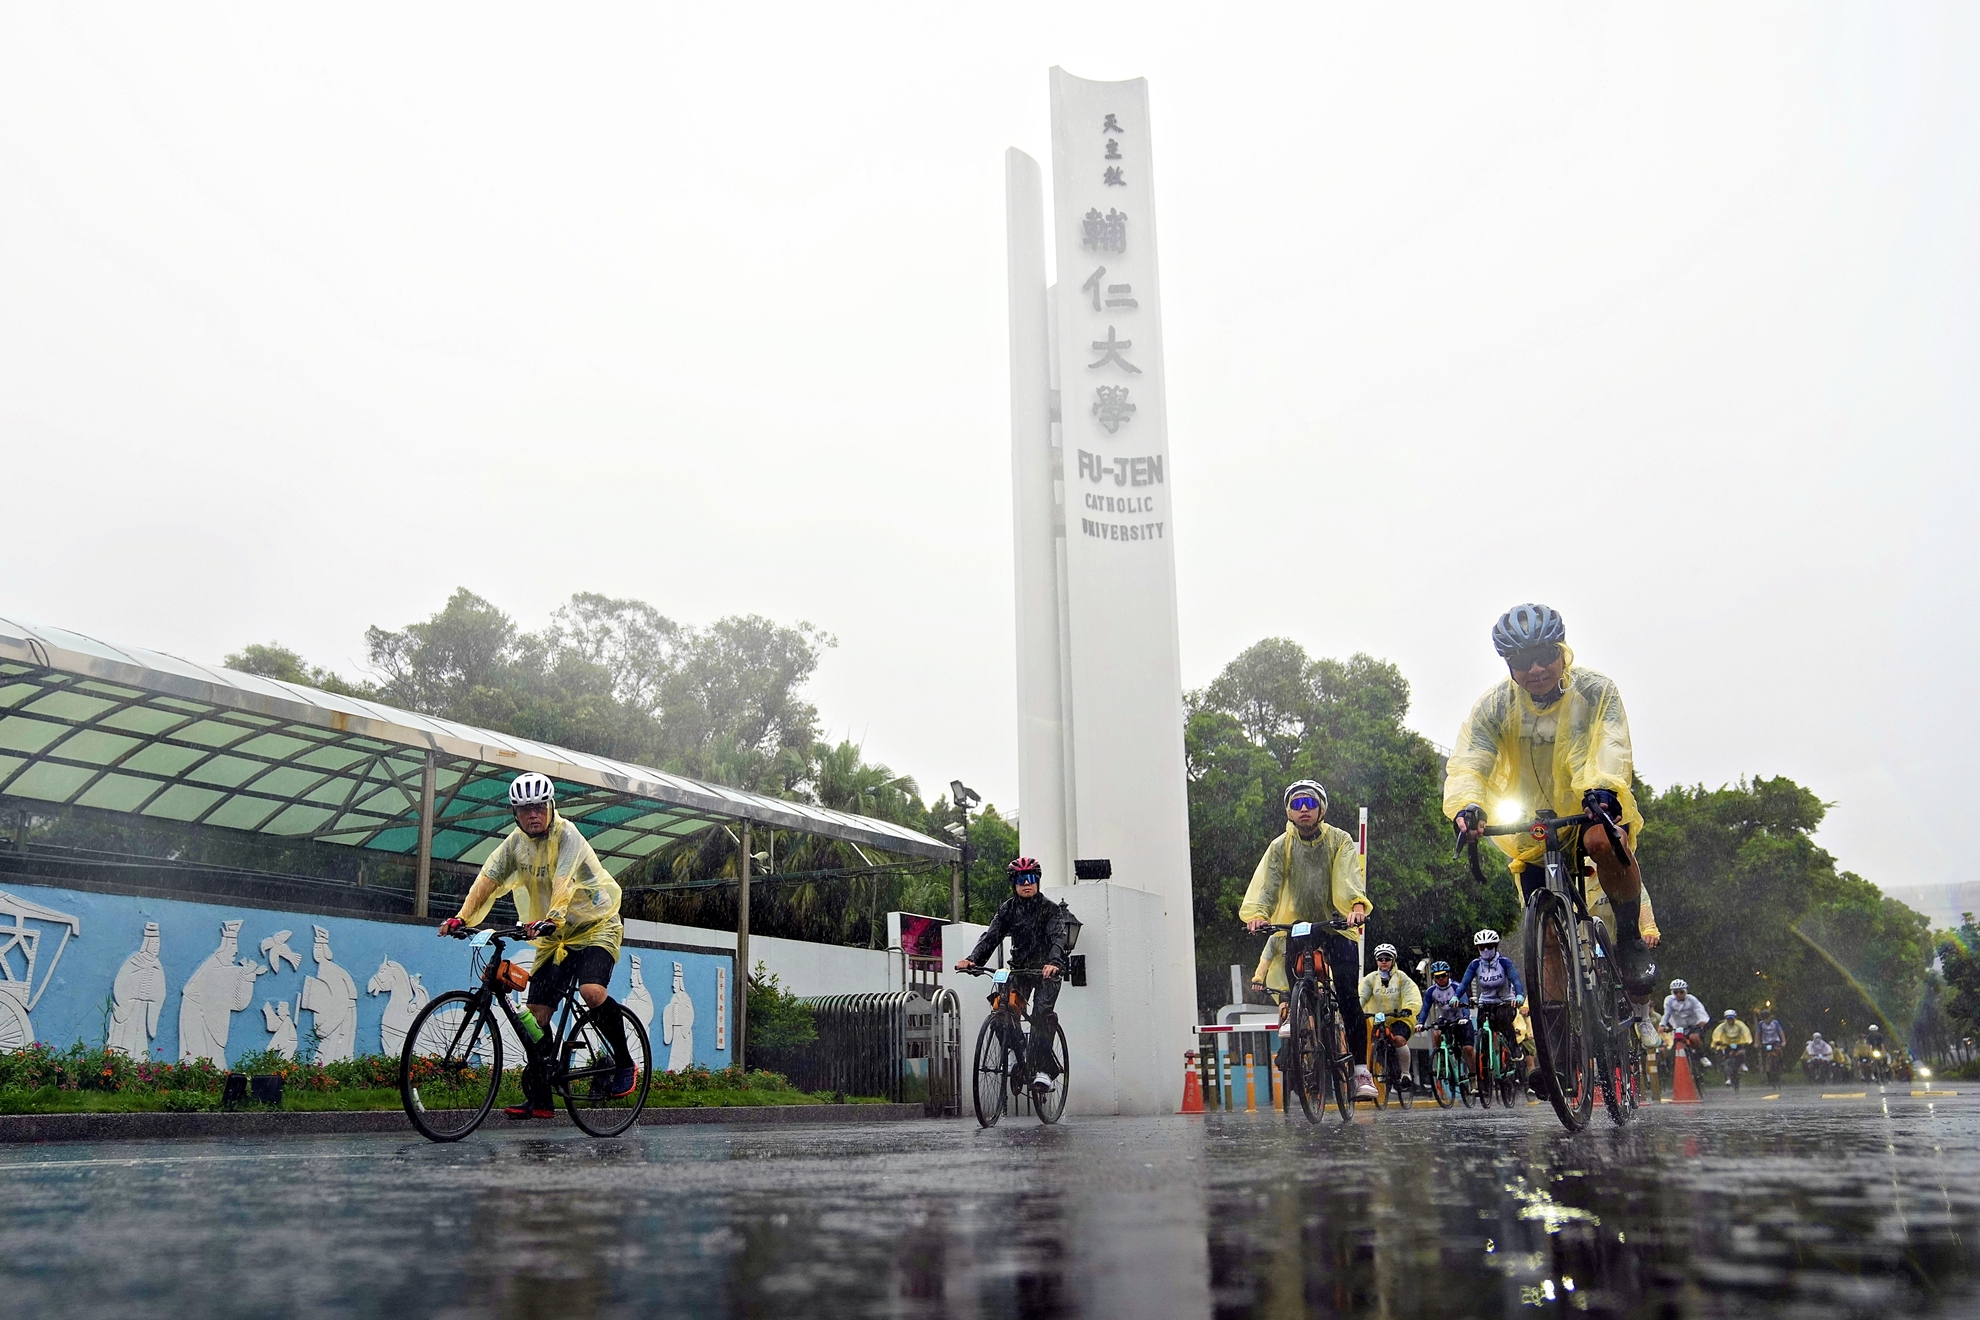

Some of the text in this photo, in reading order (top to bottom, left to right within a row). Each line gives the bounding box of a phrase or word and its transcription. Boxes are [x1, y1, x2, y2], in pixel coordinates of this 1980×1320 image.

[1083, 207, 1142, 434] 輔仁大學
[1077, 448, 1164, 487] FU-JEN
[1085, 493, 1153, 514] CATHOLIC
[1081, 517, 1164, 542] UNIVERSITY
